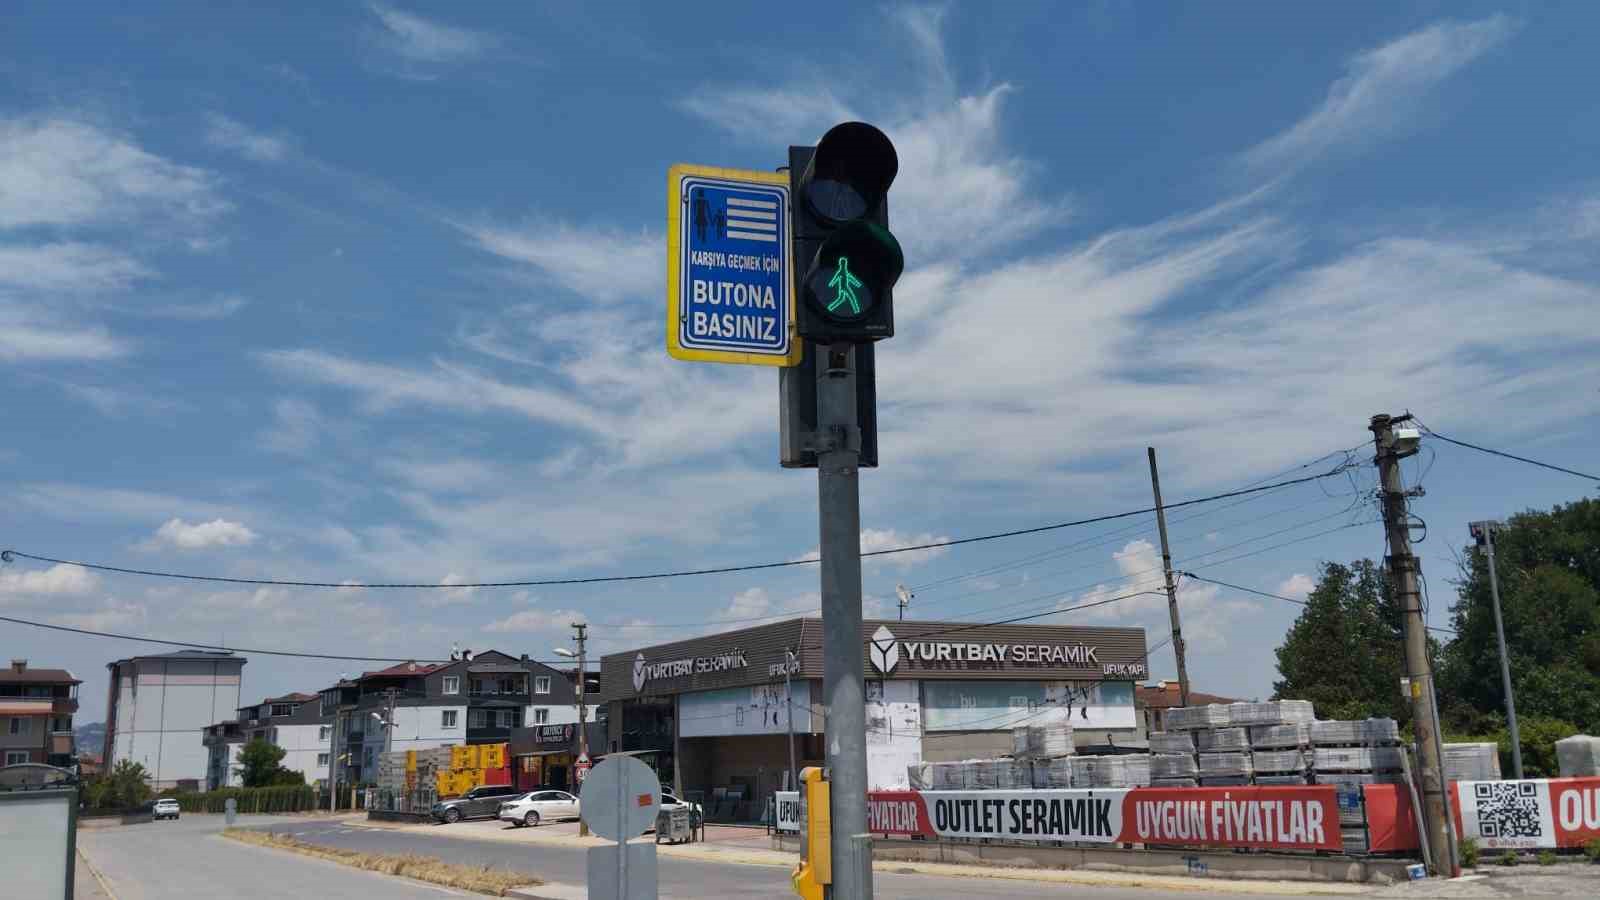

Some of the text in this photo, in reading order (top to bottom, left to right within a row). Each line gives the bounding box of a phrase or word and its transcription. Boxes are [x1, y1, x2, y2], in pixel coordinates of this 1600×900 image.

[691, 250, 780, 276] KARŞIYA GEÇMEK İÇİN
[693, 279, 777, 310] BUTONA
[694, 311, 777, 341] BASINIZ
[647, 647, 748, 680] YURTBAY SERAMİK
[902, 642, 1099, 663] YURTBAY SERAMİK
[1103, 663, 1146, 675] UFUK YAPI
[934, 791, 1113, 837] OUTLET SERAMİK
[1135, 791, 1326, 844] UYGUN FİYATLAR
